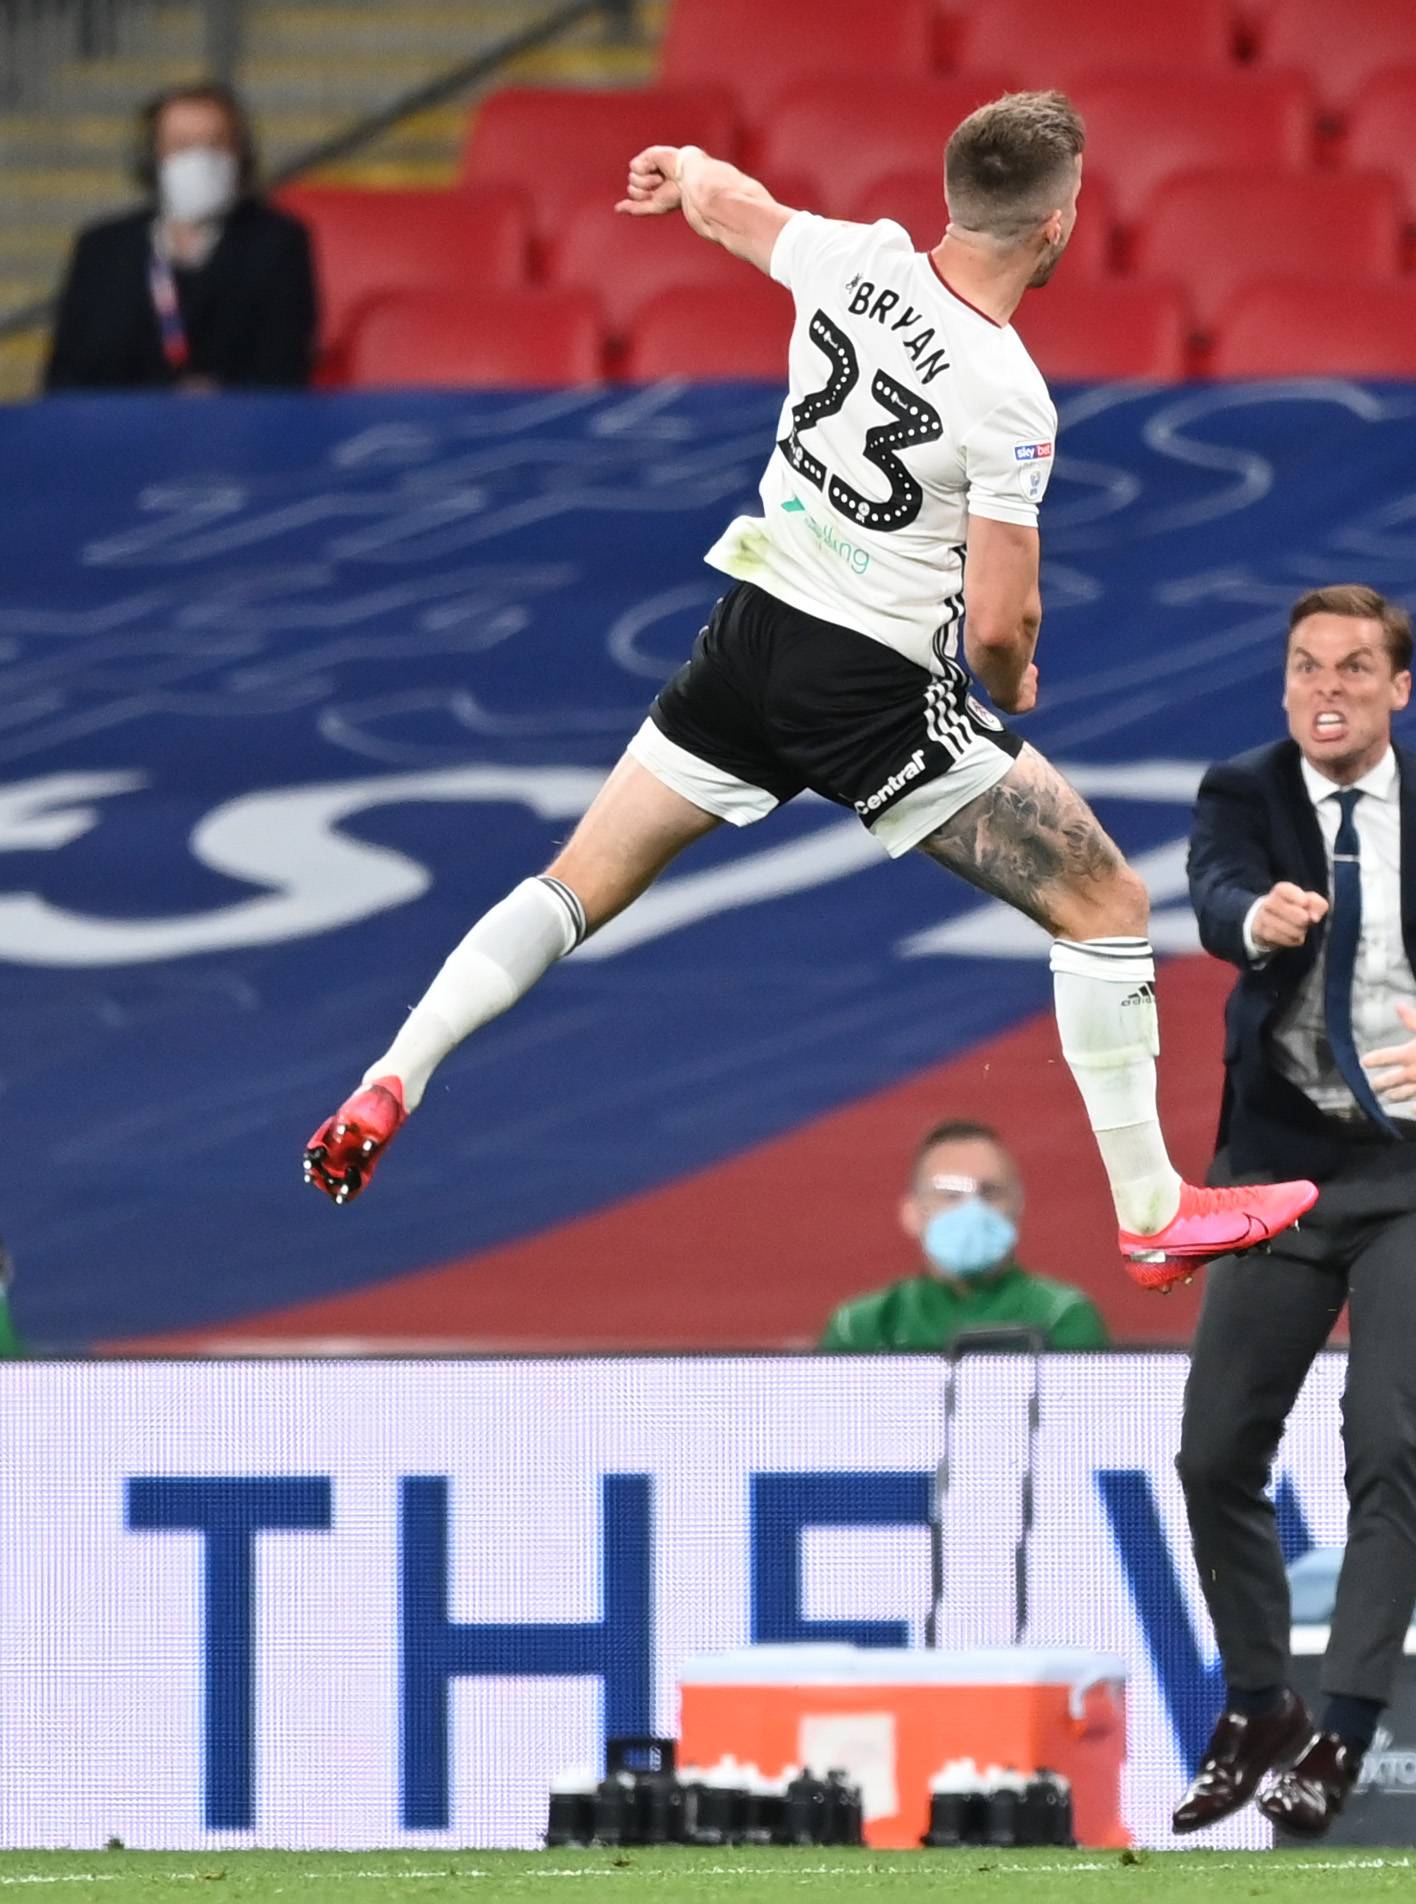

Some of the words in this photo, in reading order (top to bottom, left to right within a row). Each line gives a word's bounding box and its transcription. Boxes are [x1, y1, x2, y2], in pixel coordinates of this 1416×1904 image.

[848, 281, 950, 385] BRYAN
[777, 308, 944, 533] 23
[1016, 446, 1036, 460] sky
[854, 749, 926, 815] Central
[126, 1470, 937, 1831] THE
